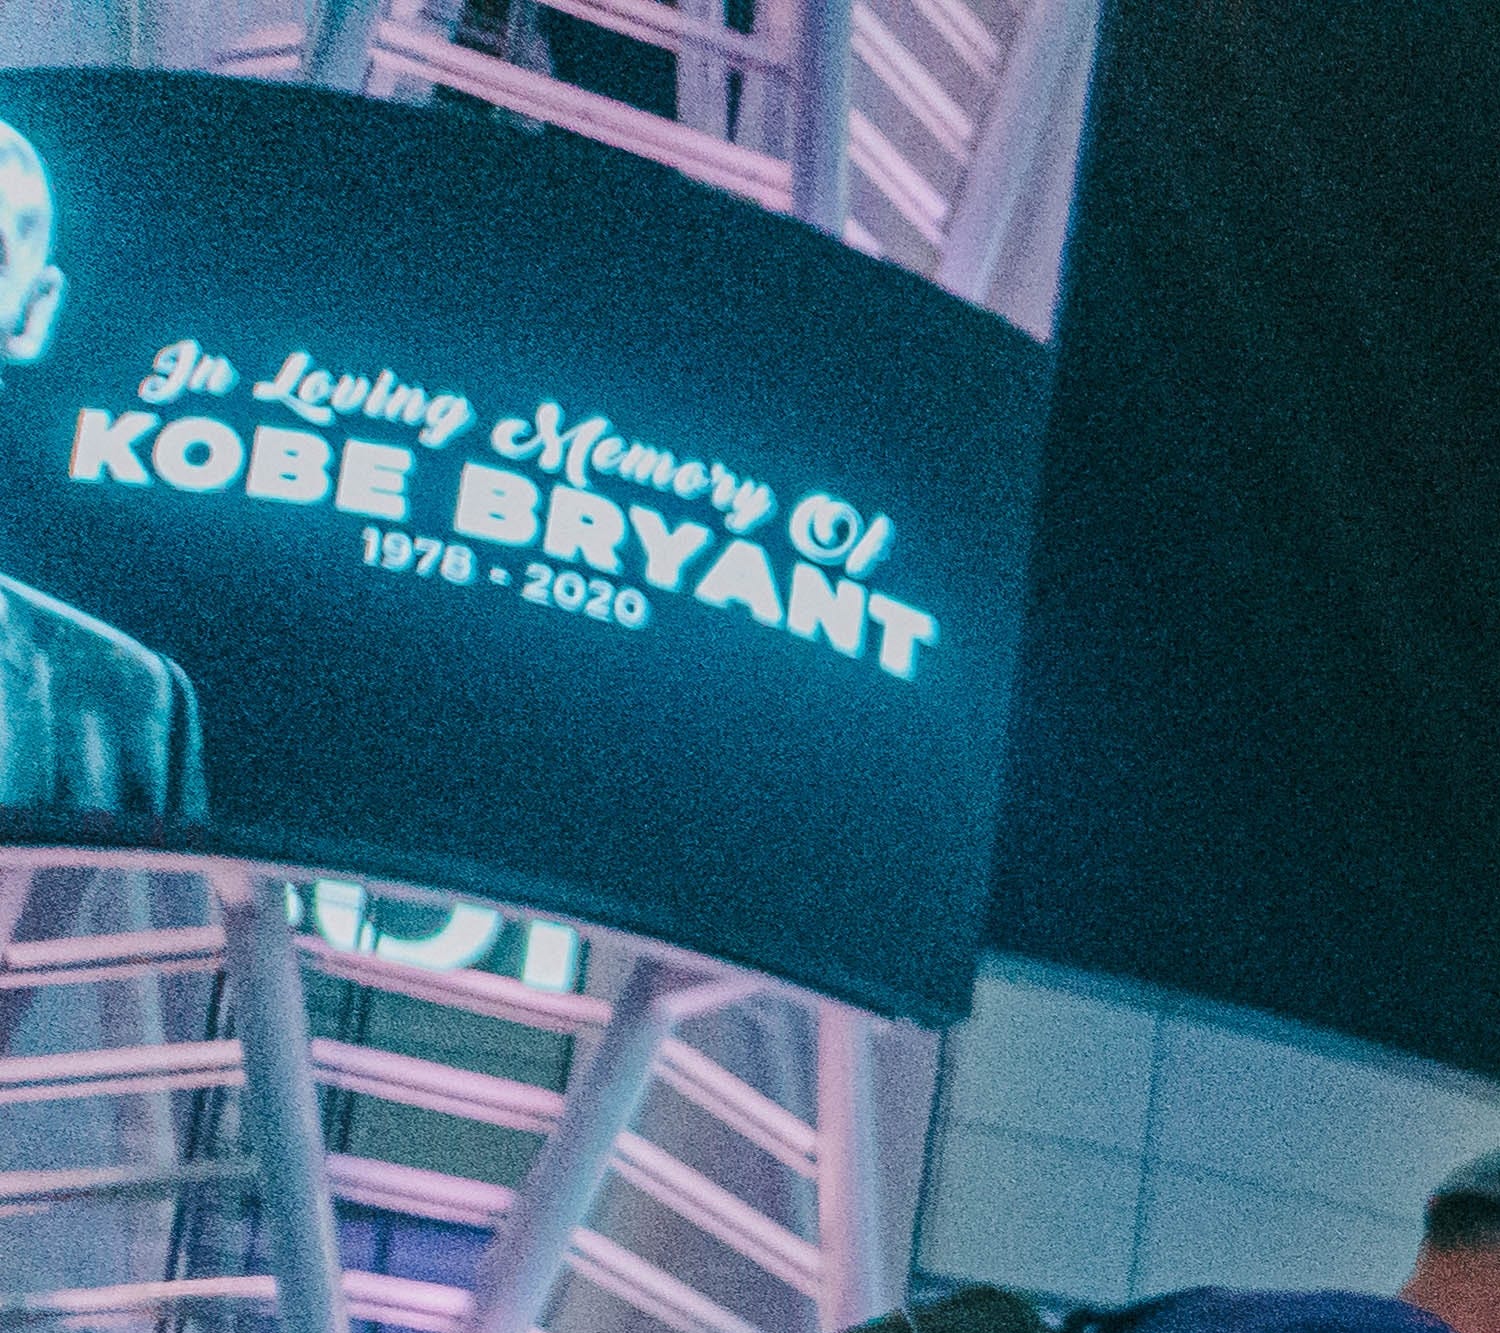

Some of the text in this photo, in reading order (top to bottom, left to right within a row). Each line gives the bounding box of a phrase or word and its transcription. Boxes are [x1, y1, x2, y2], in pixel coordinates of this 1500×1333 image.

[137, 339, 236, 403] In
[253, 350, 475, 449] Loving
[492, 403, 778, 533] Memory
[69, 408, 941, 680] KOBE BRYANT
[361, 526, 473, 585] 1978
[521, 563, 650, 630] 2020
